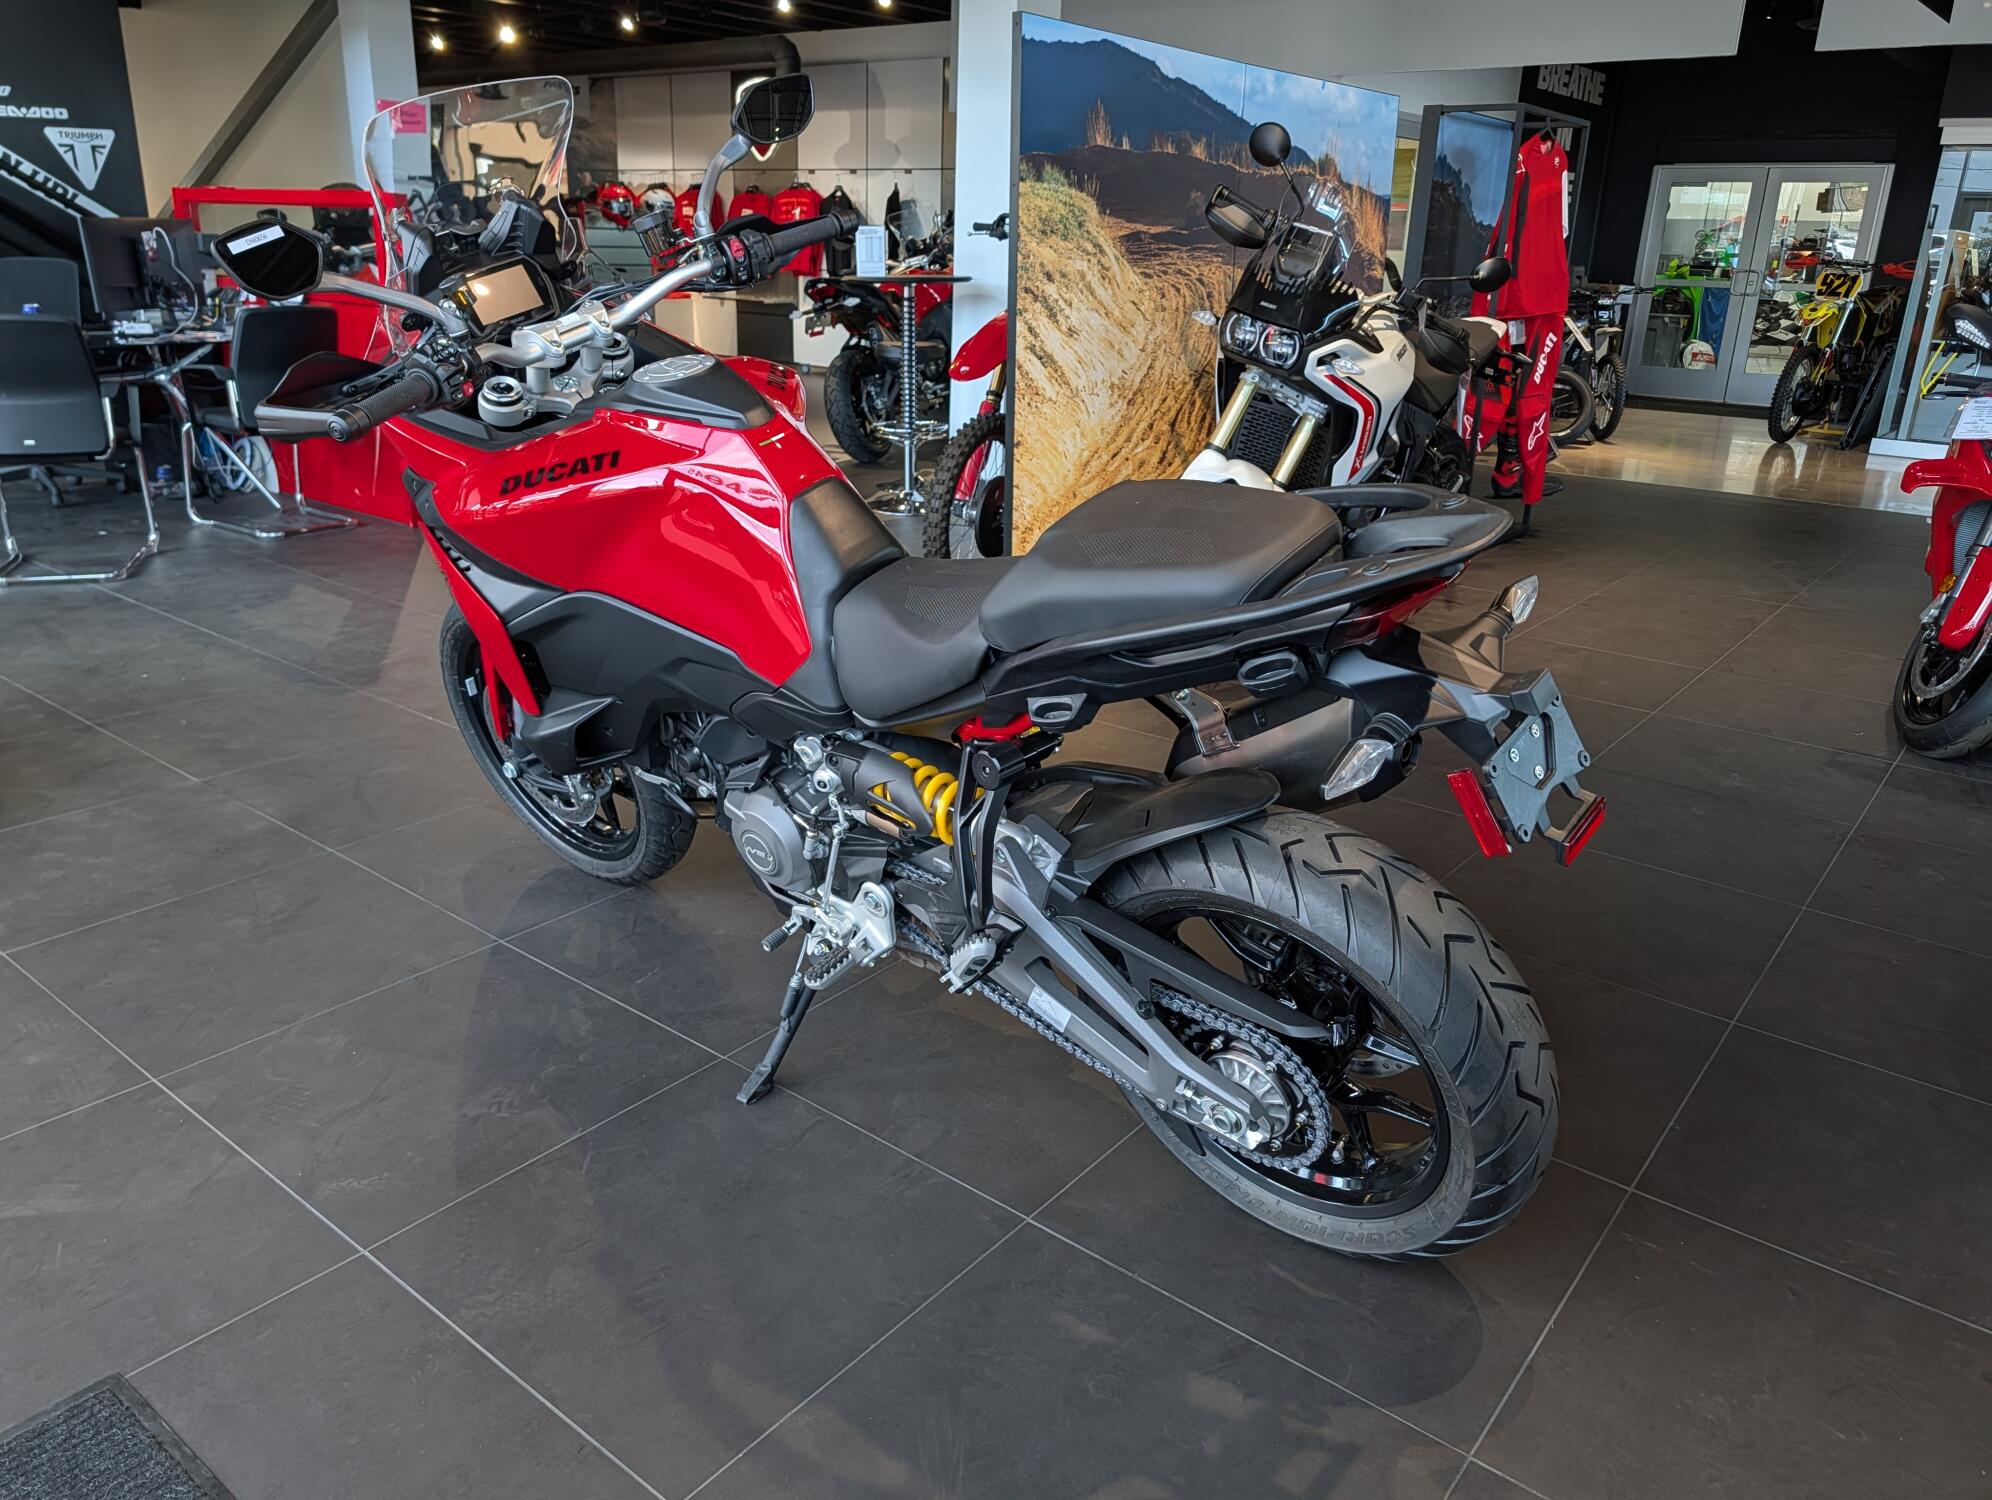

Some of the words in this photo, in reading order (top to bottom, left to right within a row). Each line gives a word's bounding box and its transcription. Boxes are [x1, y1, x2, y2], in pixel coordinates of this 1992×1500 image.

[1537, 64, 1606, 106] BREATHE
[58, 130, 104, 140] TRIUMPH
[1817, 273, 1858, 299] 921
[1533, 332, 1558, 385] DUCATI
[500, 450, 622, 496] DUCATI
